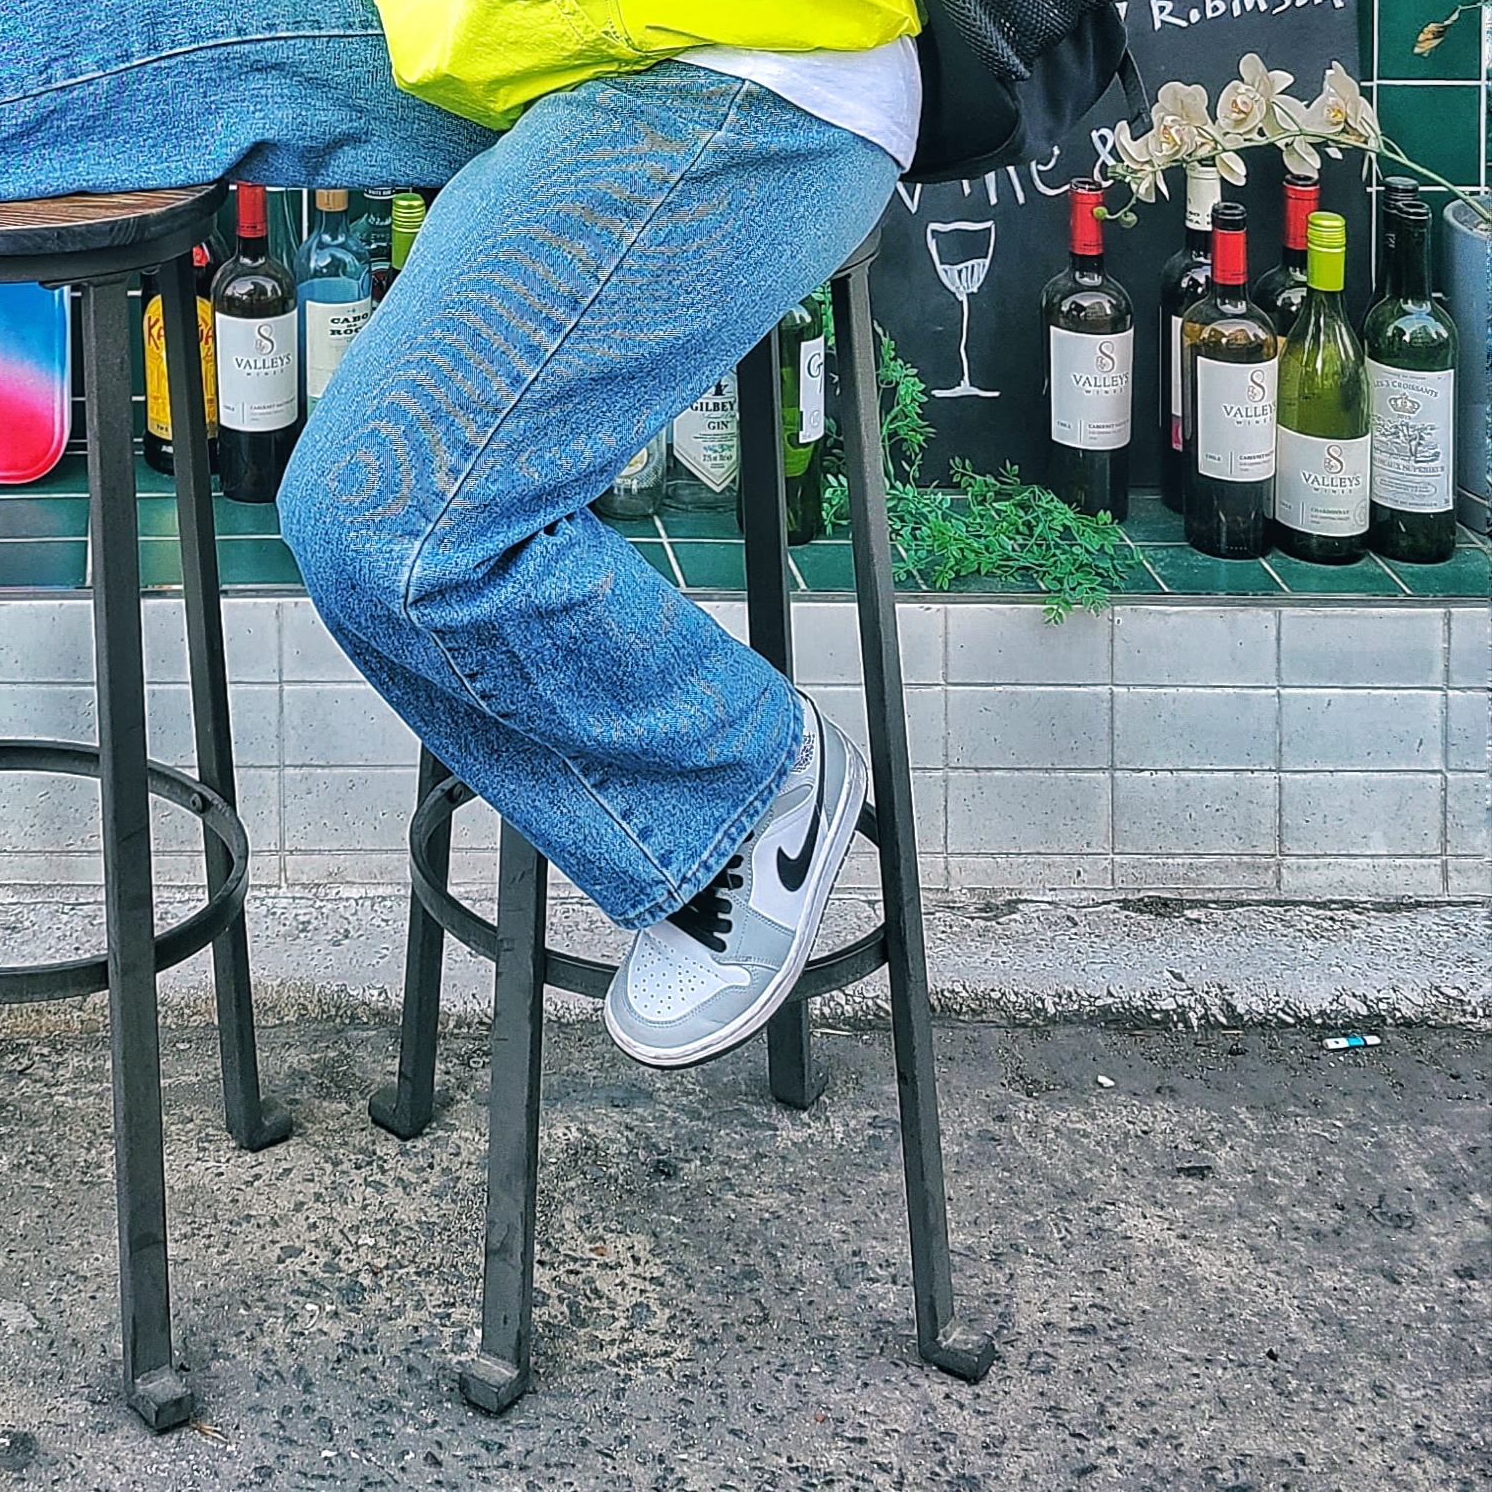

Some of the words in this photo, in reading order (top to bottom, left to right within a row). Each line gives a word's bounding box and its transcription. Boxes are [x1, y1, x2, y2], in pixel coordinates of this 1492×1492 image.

[330, 313, 369, 324] CABO
[234, 353, 292, 370] VALLEYS
[1072, 371, 1130, 388] VALLEYS
[707, 420, 730, 431] GIN
[1301, 471, 1361, 488] VALLEYS
